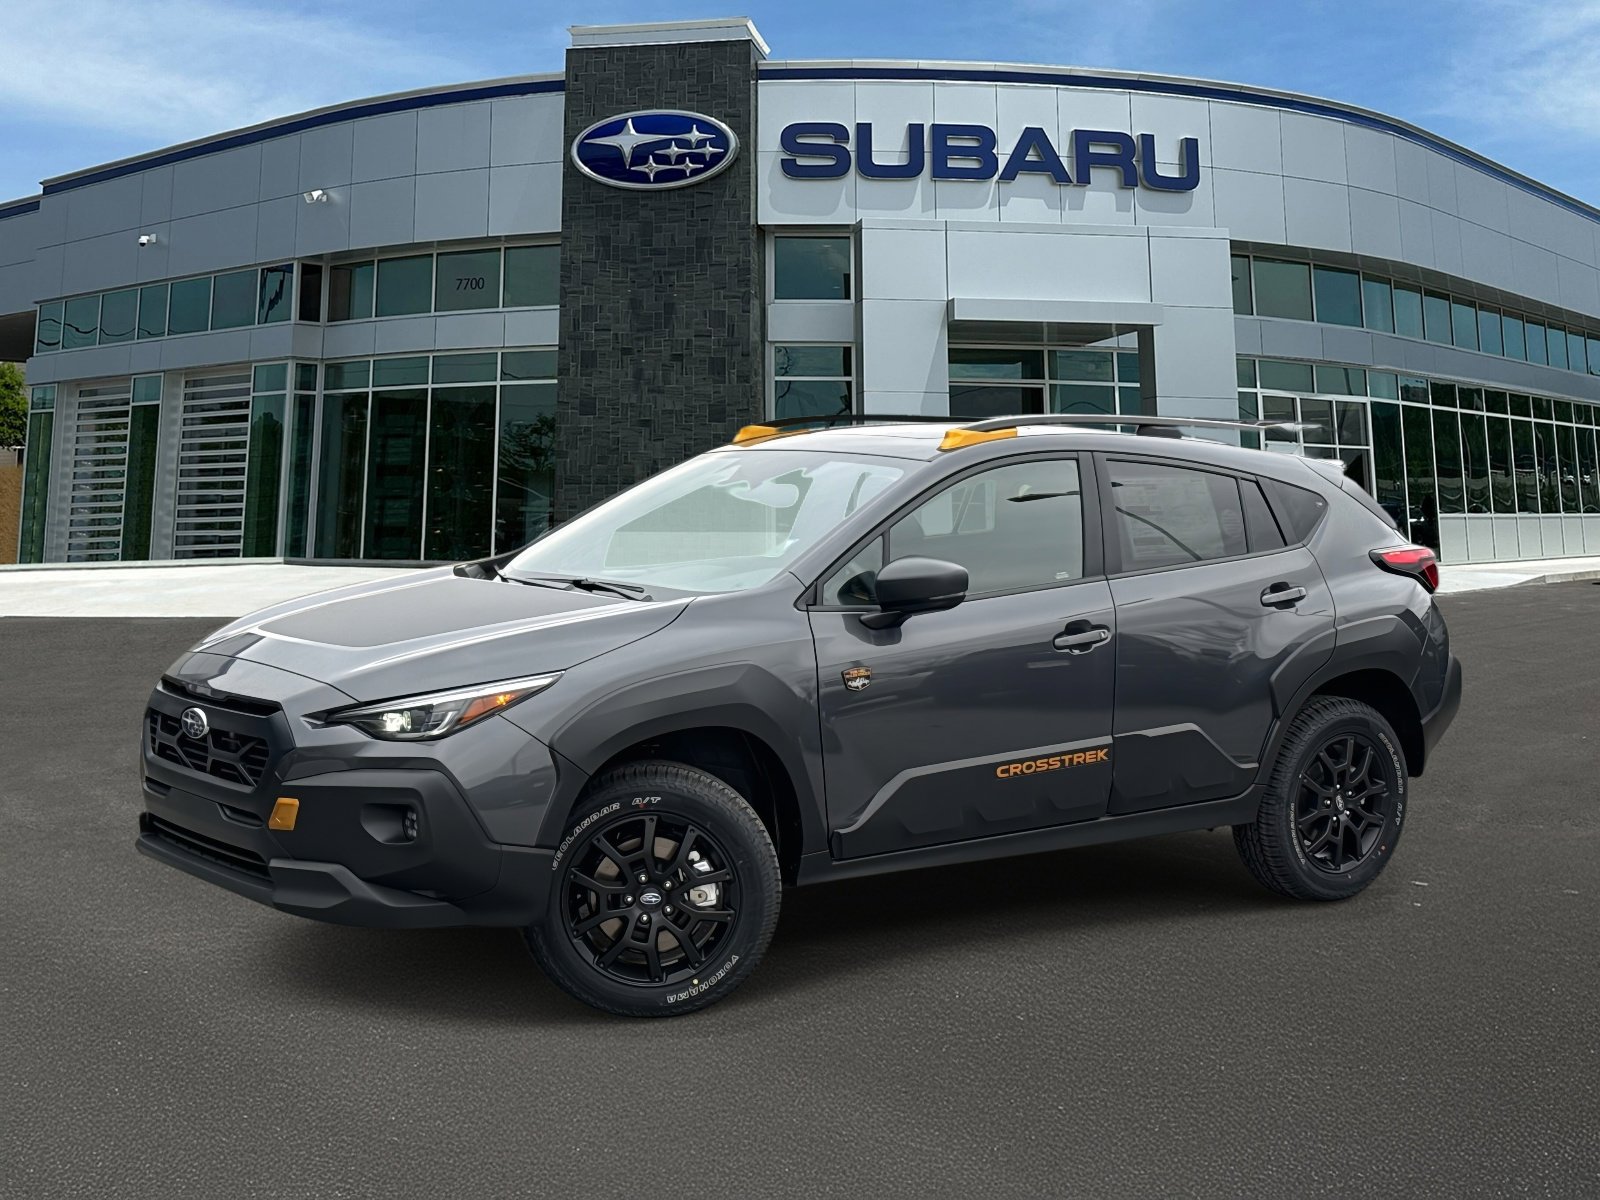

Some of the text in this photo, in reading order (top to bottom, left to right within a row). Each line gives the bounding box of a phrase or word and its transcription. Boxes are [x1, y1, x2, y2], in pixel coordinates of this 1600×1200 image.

[780, 122, 1200, 192] SUBARU
[455, 277, 485, 290] 7700
[996, 748, 1109, 778] CROSSTREK
[551, 796, 661, 871] GEOLANDAR A/T
[666, 954, 740, 1004] YOKOHAMA
